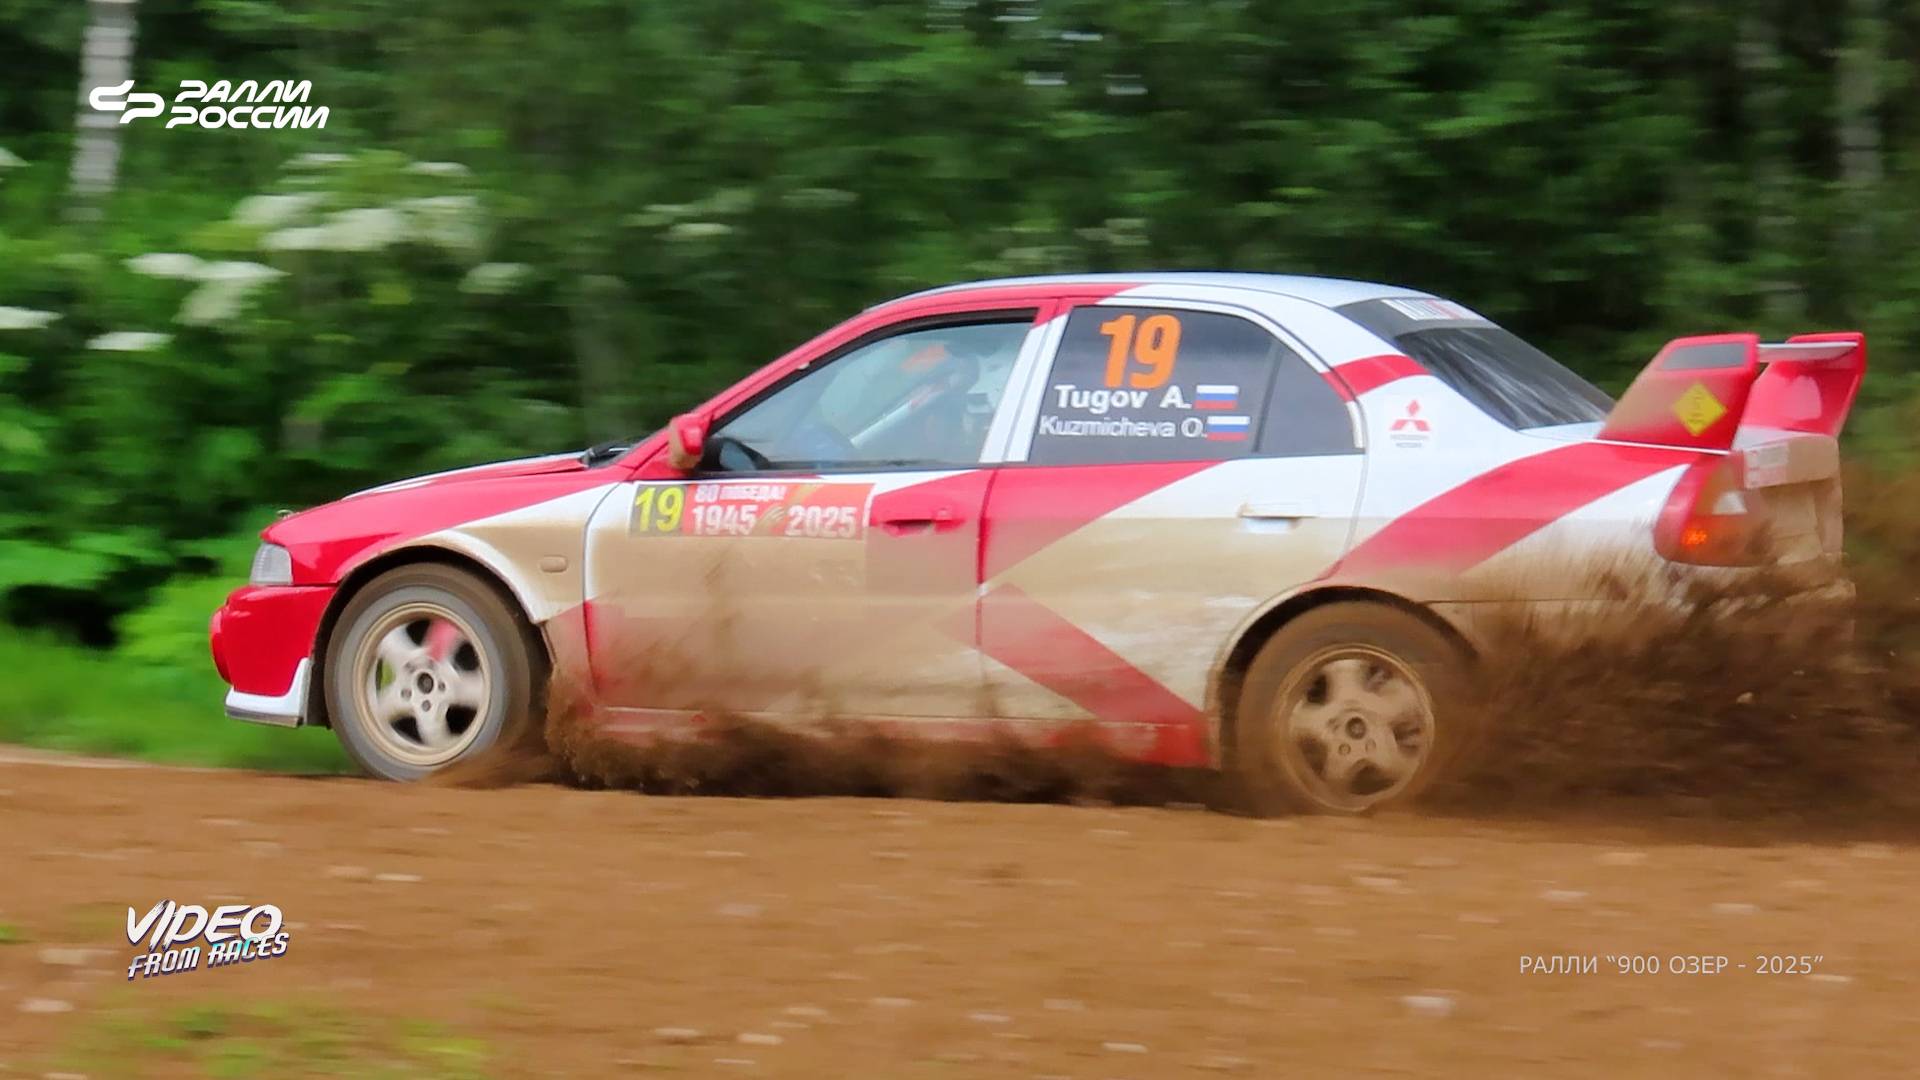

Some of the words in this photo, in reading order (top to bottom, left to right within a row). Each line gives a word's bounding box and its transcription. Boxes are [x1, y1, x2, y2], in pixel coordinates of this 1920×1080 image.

[1099, 313, 1182, 390] 19
[1054, 384, 1149, 414] Tugov
[1159, 385, 1192, 409] A.
[1039, 415, 1177, 438] Kuzmicheva
[1180, 417, 1208, 438] O.
[694, 484, 720, 502] 80
[635, 486, 685, 534] 19
[692, 504, 758, 537] 1945
[784, 505, 859, 538] 2025
